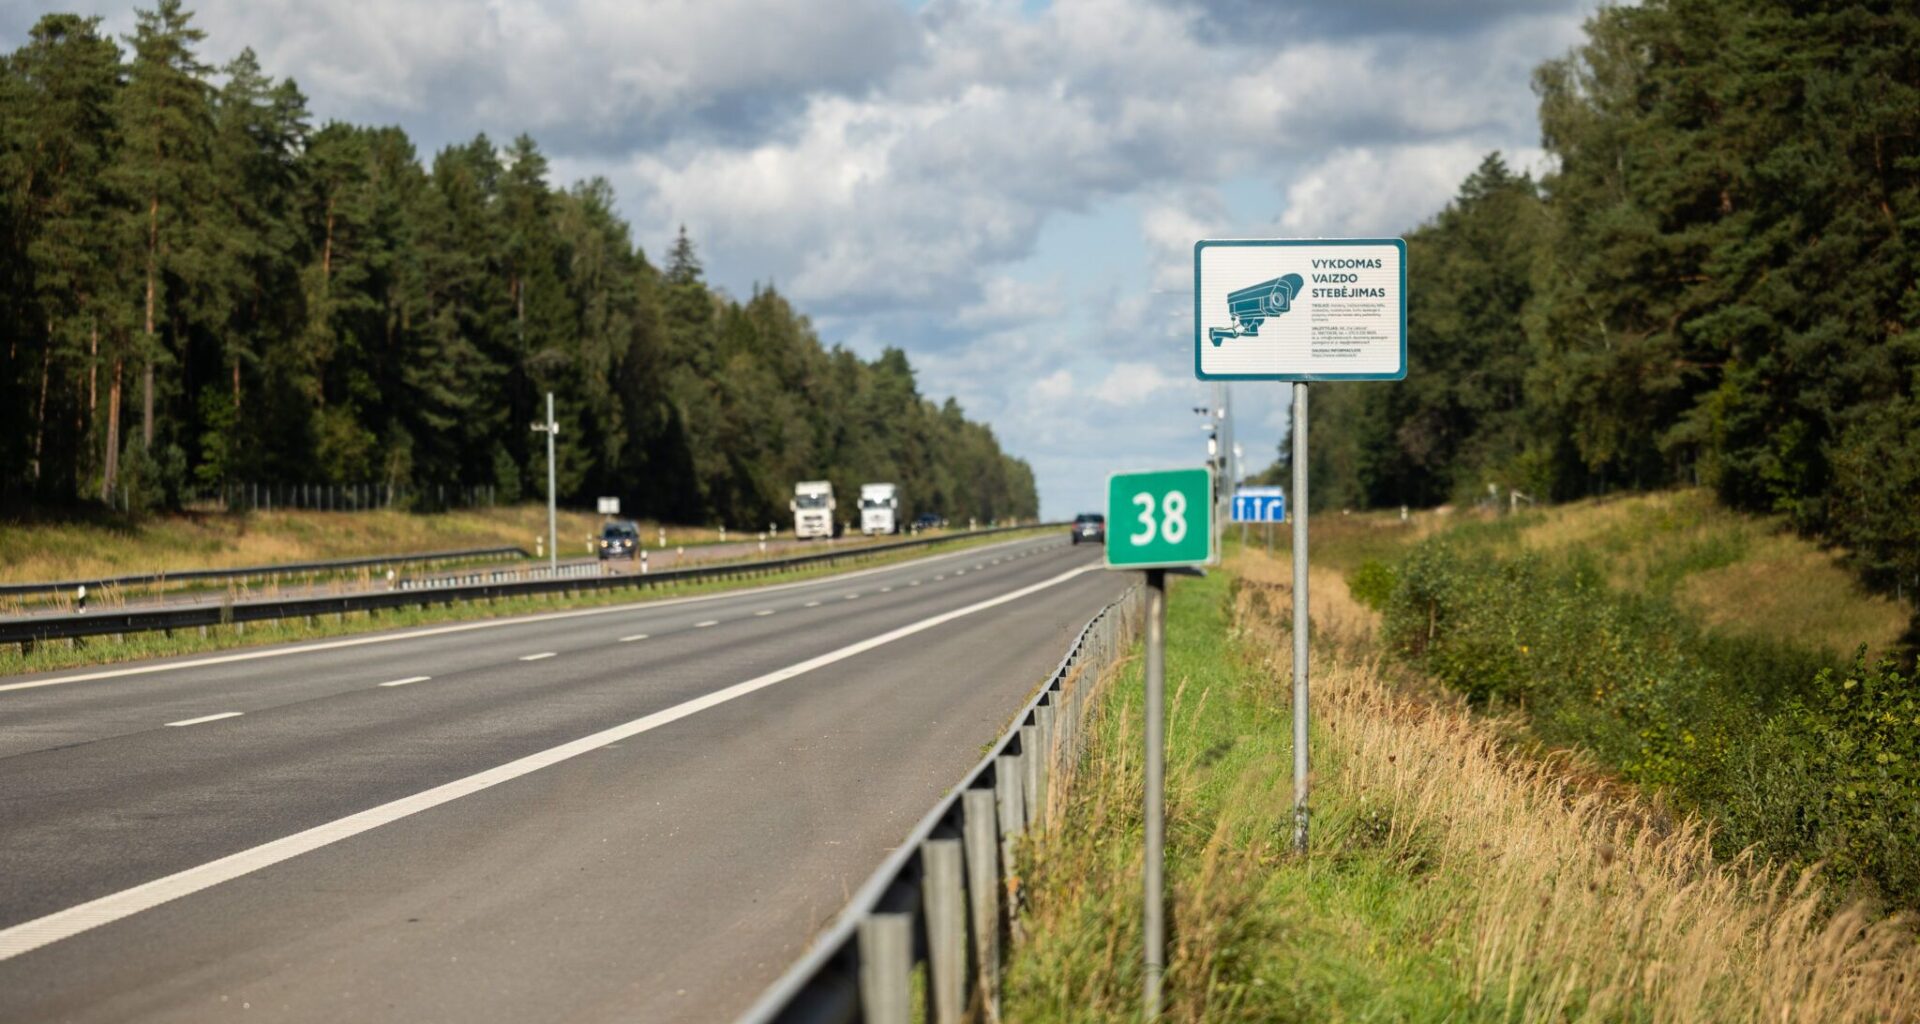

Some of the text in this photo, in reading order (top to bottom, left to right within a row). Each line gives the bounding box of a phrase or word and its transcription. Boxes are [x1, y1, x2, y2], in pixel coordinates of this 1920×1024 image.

[1312, 259, 1382, 269] VYKDOMAS
[1312, 273, 1358, 283] VAIZDO
[1312, 286, 1386, 298] STEBĖJIMAS
[1130, 490, 1187, 546] 38
